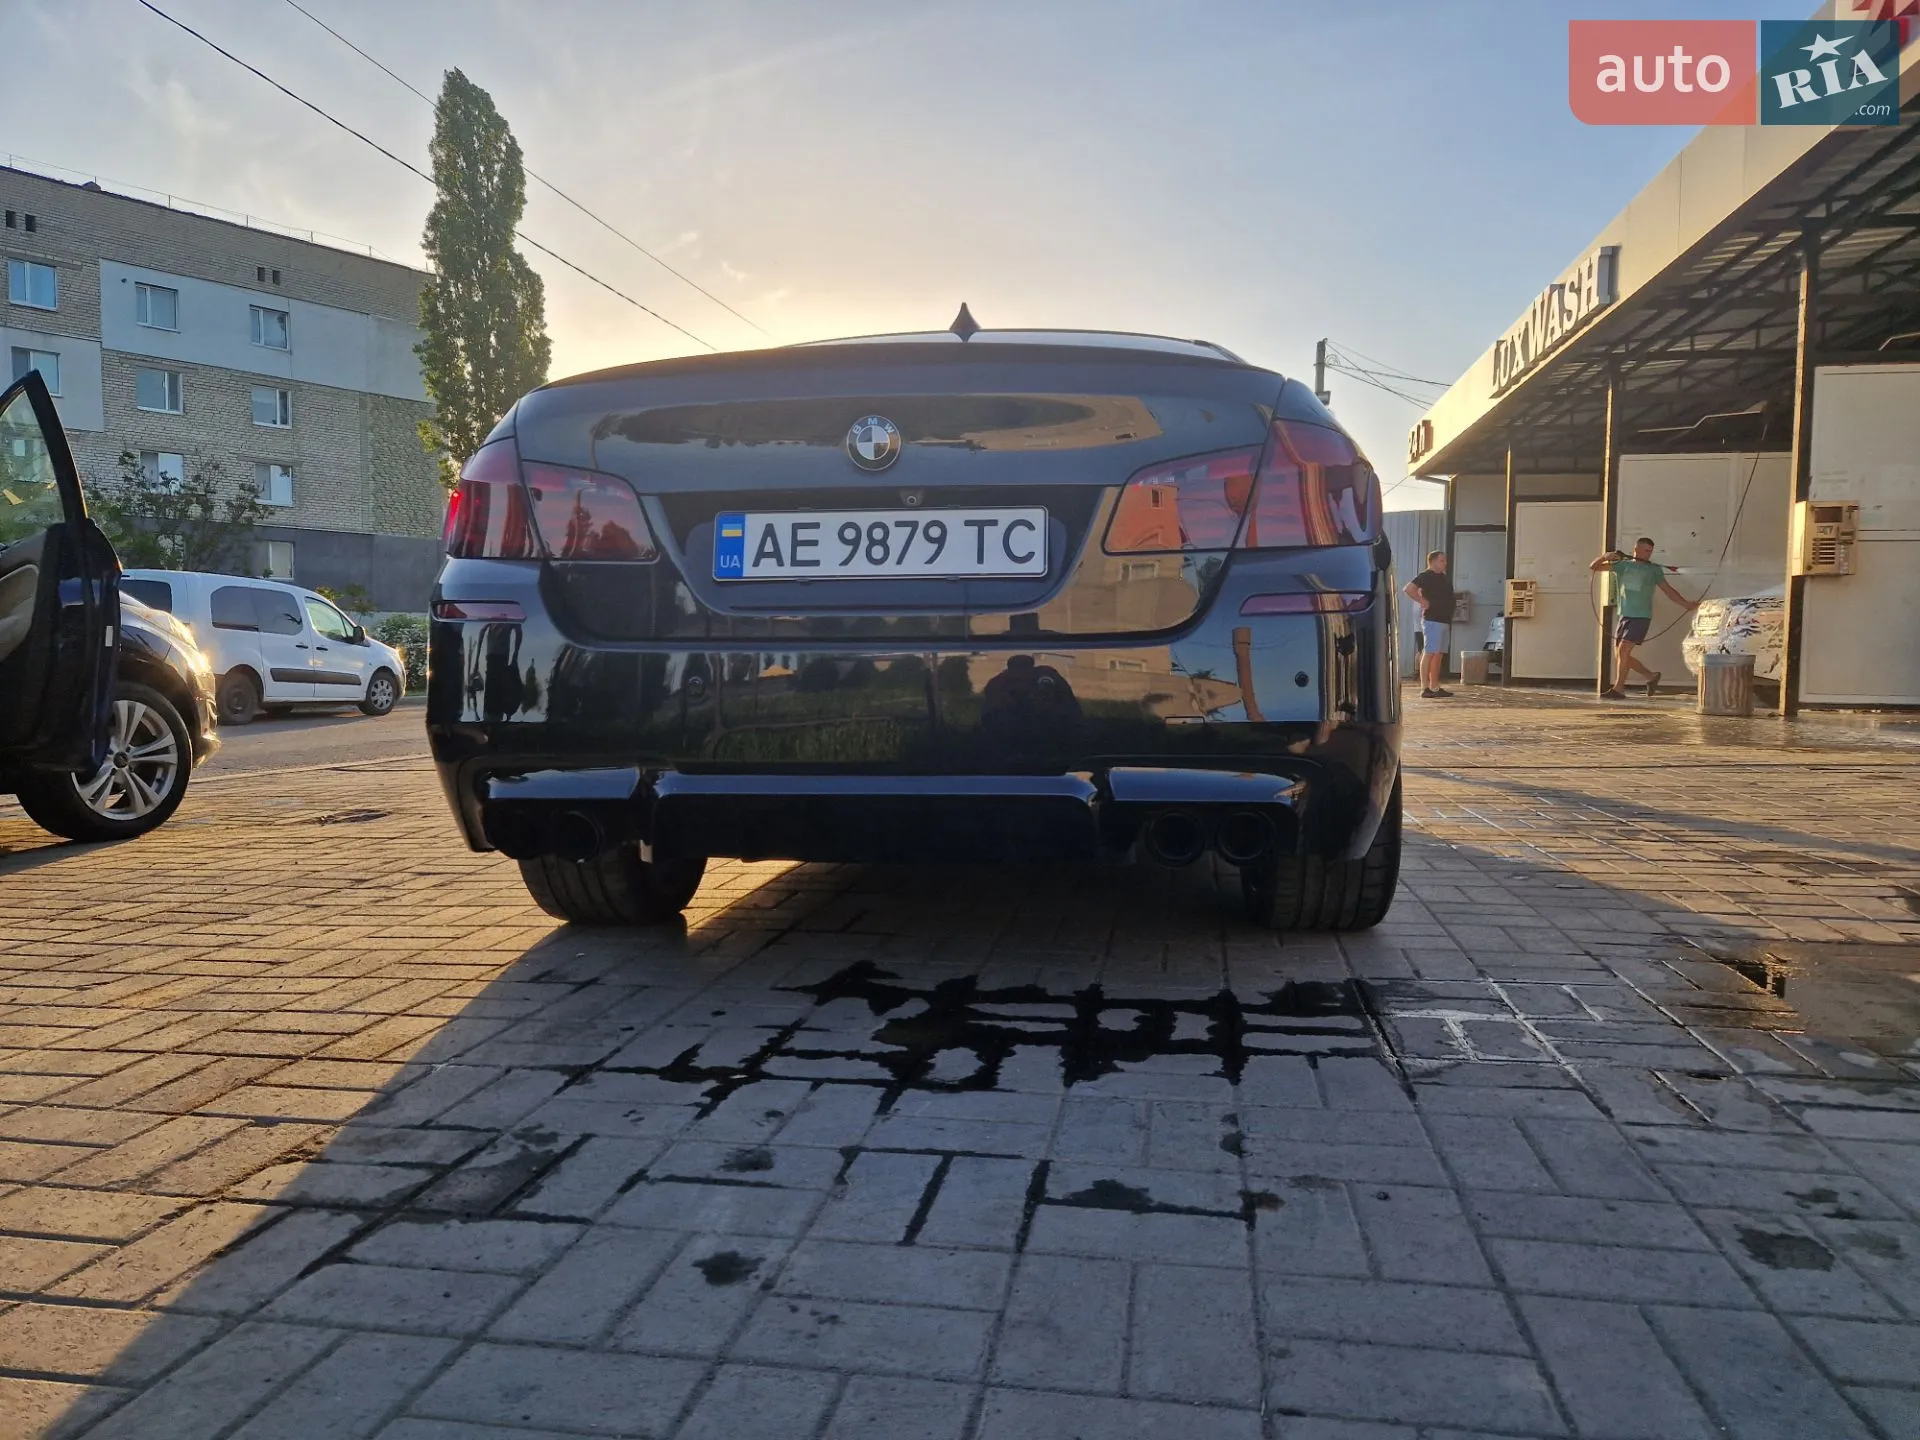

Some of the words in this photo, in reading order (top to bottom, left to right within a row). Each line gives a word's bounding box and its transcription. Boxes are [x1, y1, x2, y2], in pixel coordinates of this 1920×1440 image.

[752, 521, 821, 567] AE
[837, 519, 948, 566] 9879
[963, 519, 1036, 565] TC
[720, 553, 740, 568] UA
